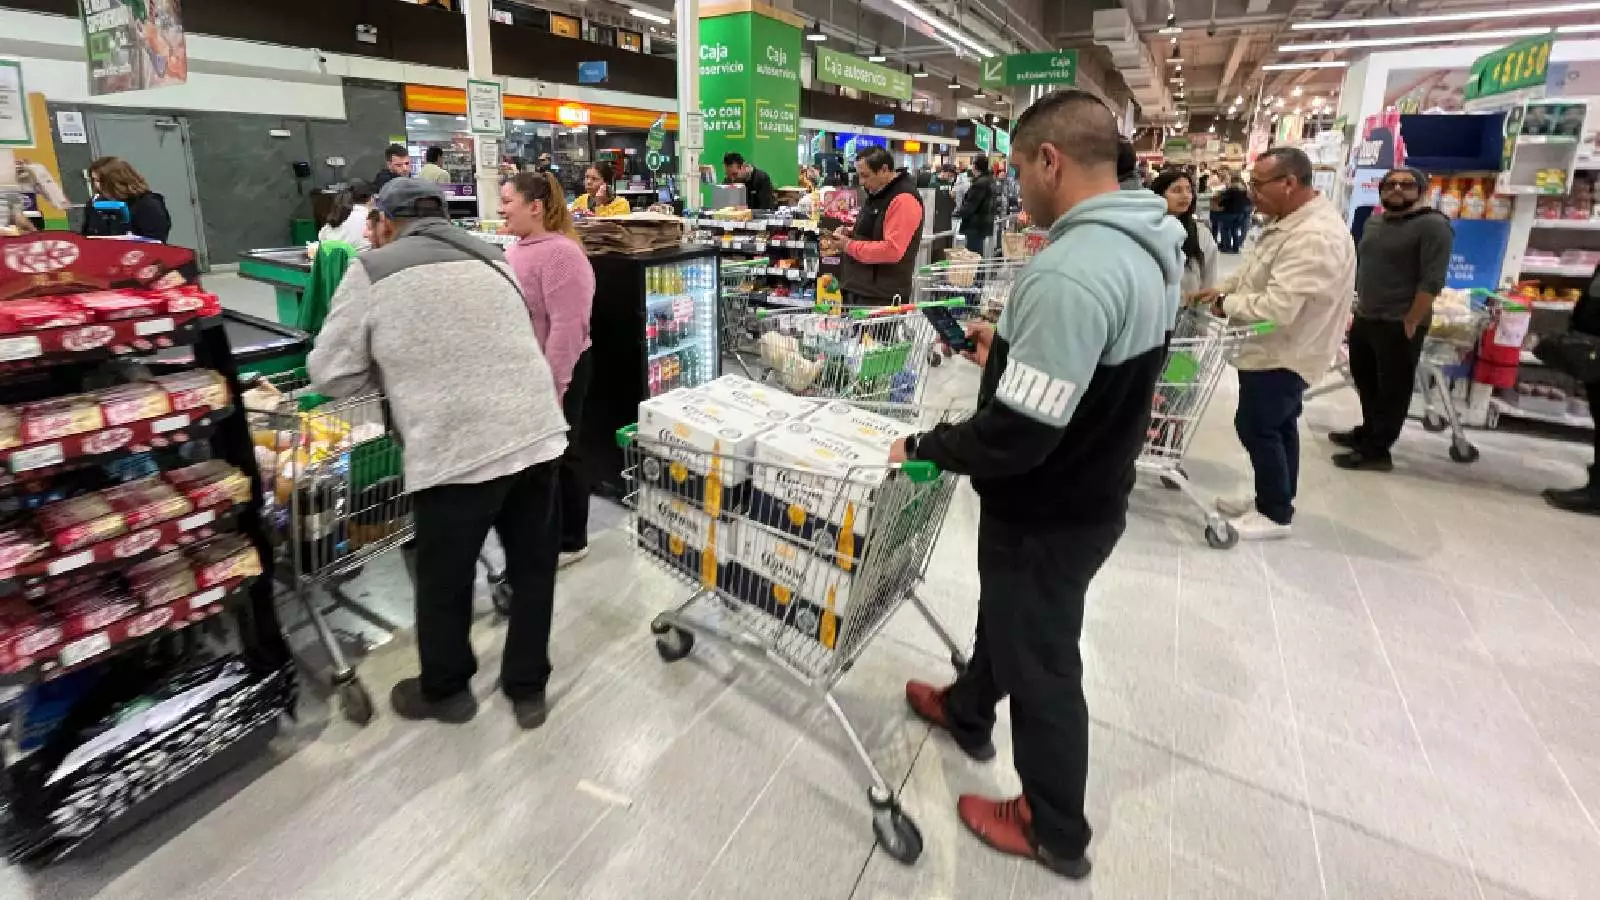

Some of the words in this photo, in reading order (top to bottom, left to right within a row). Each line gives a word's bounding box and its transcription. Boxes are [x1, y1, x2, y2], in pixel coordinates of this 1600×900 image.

[699, 42, 728, 63] Caja
[766, 45, 787, 67] Caja
[1050, 56, 1071, 68] Caja
[756, 63, 797, 81] autoservicio
[824, 55, 842, 79] Caja
[843, 64, 887, 88] autoservicio
[1016, 68, 1069, 81] autoservicio
[719, 106, 741, 117] CON
[760, 107, 779, 120] SOLO
[780, 110, 794, 121] CON
[759, 121, 794, 133] TARJETAS
